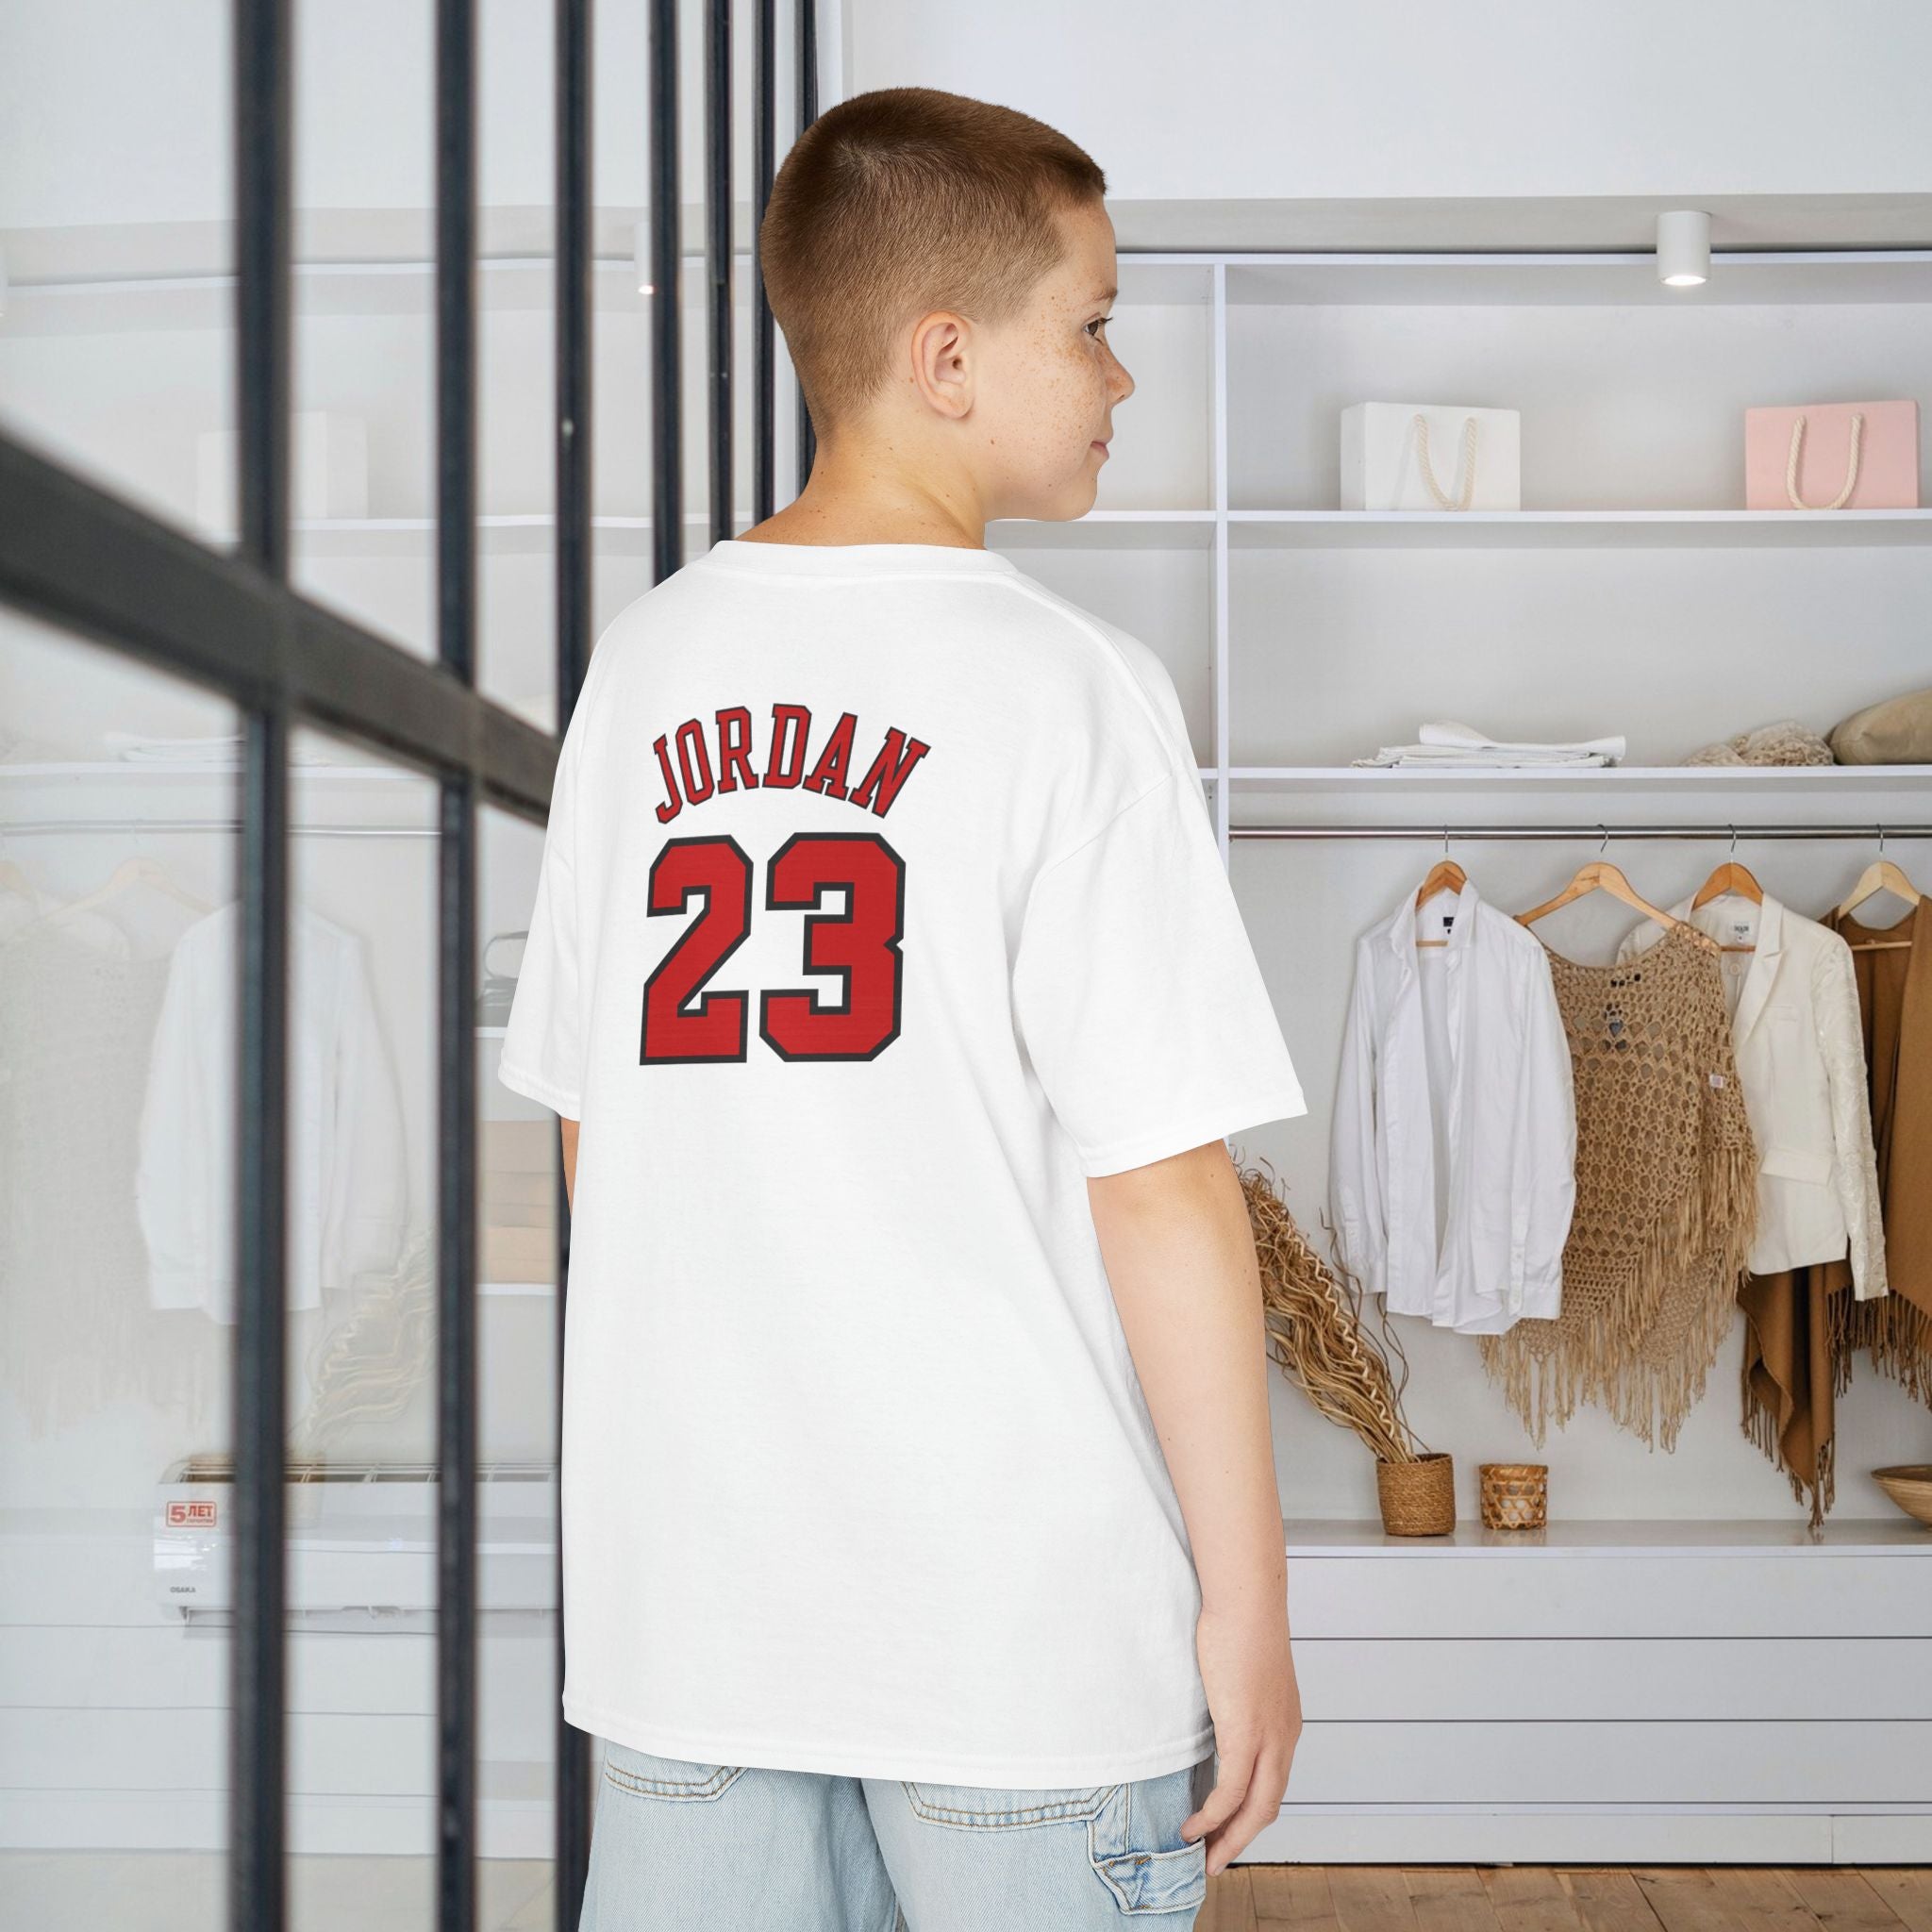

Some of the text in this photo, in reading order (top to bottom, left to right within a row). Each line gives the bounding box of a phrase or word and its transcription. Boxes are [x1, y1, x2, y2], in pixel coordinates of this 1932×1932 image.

[653, 703, 932, 824] JORDAN
[640, 832, 907, 1066] 23
[170, 1505, 213, 1523] 5 ЛЕТ
